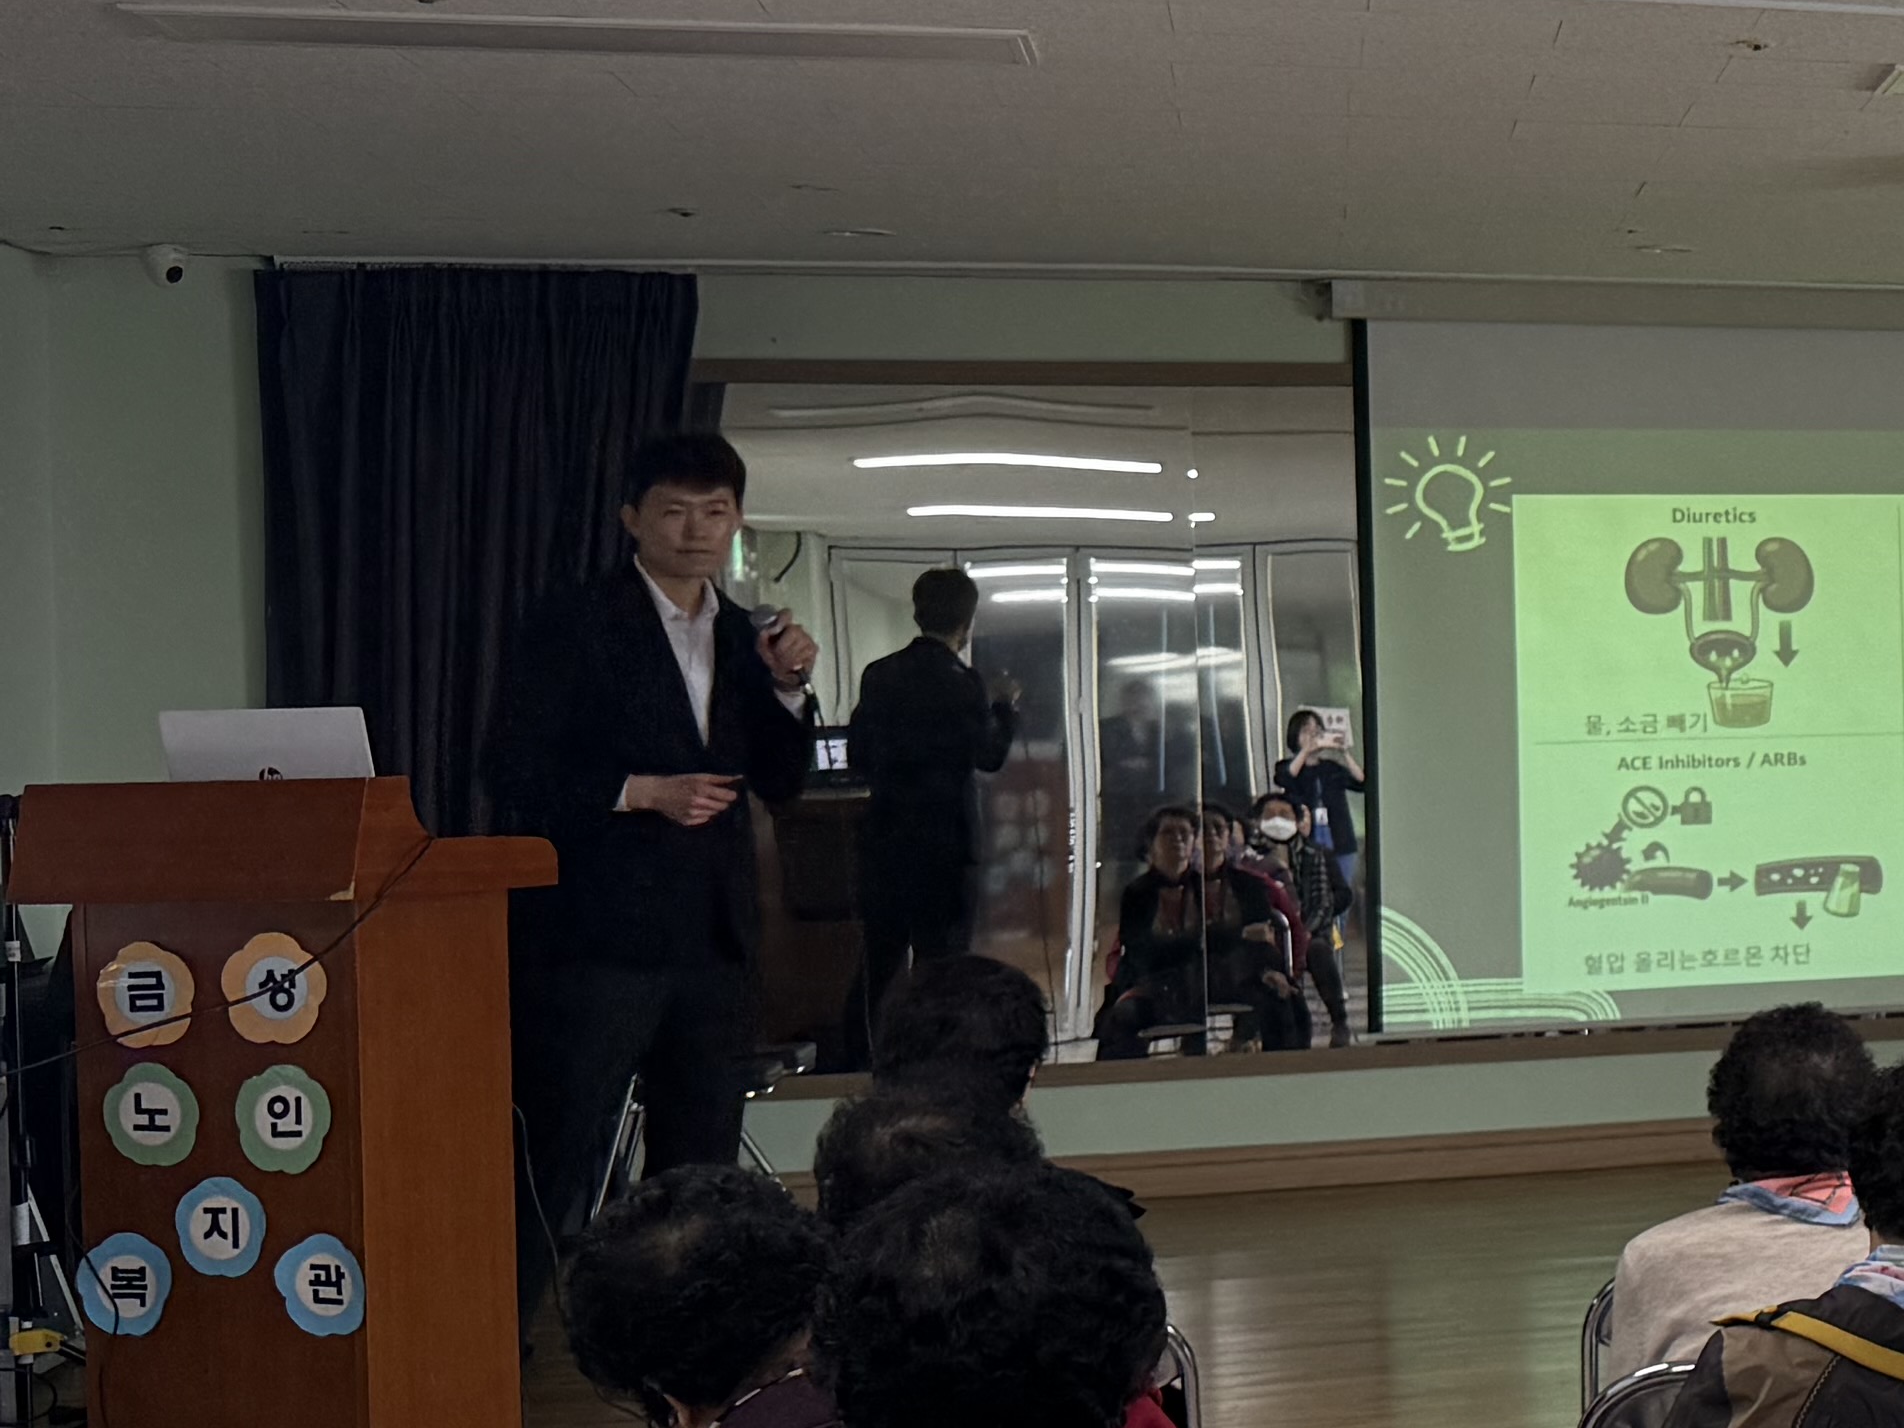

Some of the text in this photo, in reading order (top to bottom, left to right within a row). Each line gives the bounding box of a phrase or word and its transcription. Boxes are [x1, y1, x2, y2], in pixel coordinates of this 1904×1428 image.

[1672, 507, 1757, 525] Diuretics
[1617, 713, 1659, 735] 소금
[1666, 712, 1708, 734] 빼기
[1617, 756, 1652, 772] ACE
[1658, 753, 1741, 771] Inhibitors
[1760, 751, 1807, 768] ARBs
[1584, 952, 1625, 975] 혈압
[1770, 943, 1811, 966] 차단
[127, 969, 296, 1013] 금 성
[133, 1093, 303, 1138] 노 인
[111, 1207, 345, 1308] 복 지 관
